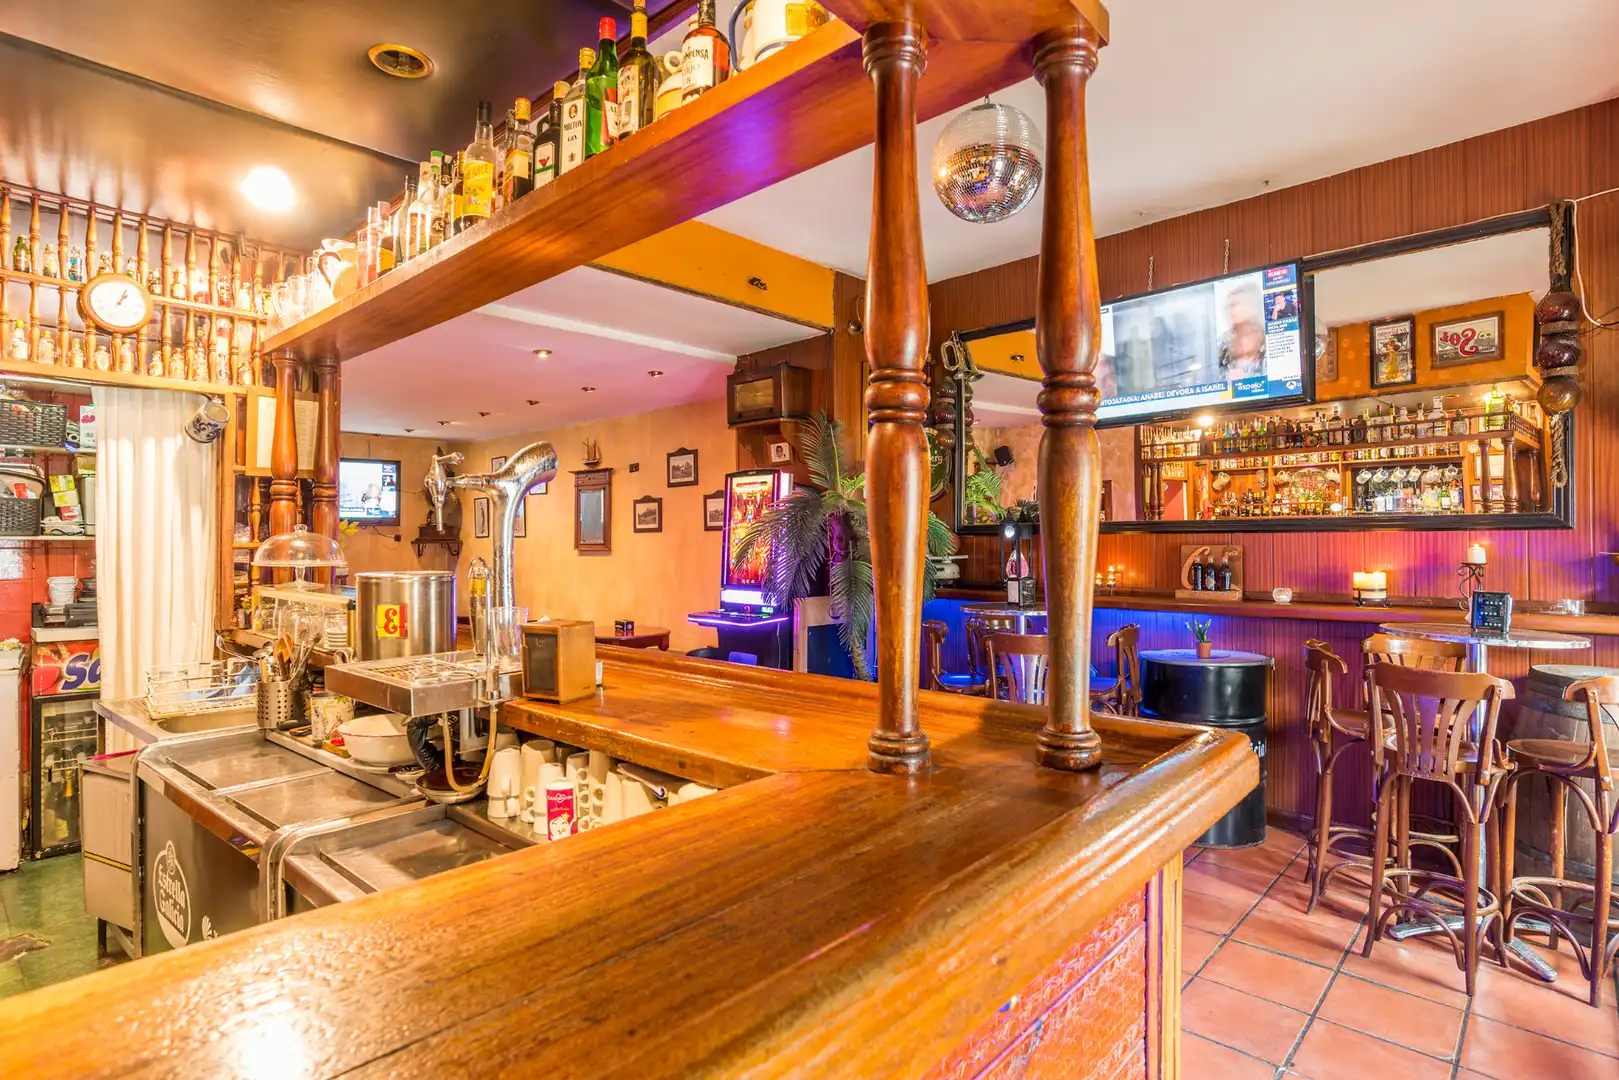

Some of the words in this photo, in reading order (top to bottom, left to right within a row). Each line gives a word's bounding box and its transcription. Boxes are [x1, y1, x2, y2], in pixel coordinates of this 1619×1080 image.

[1140, 391, 1165, 401] ANABEL
[1166, 387, 1194, 397] DEVORA
[1201, 383, 1226, 392] ISABEL
